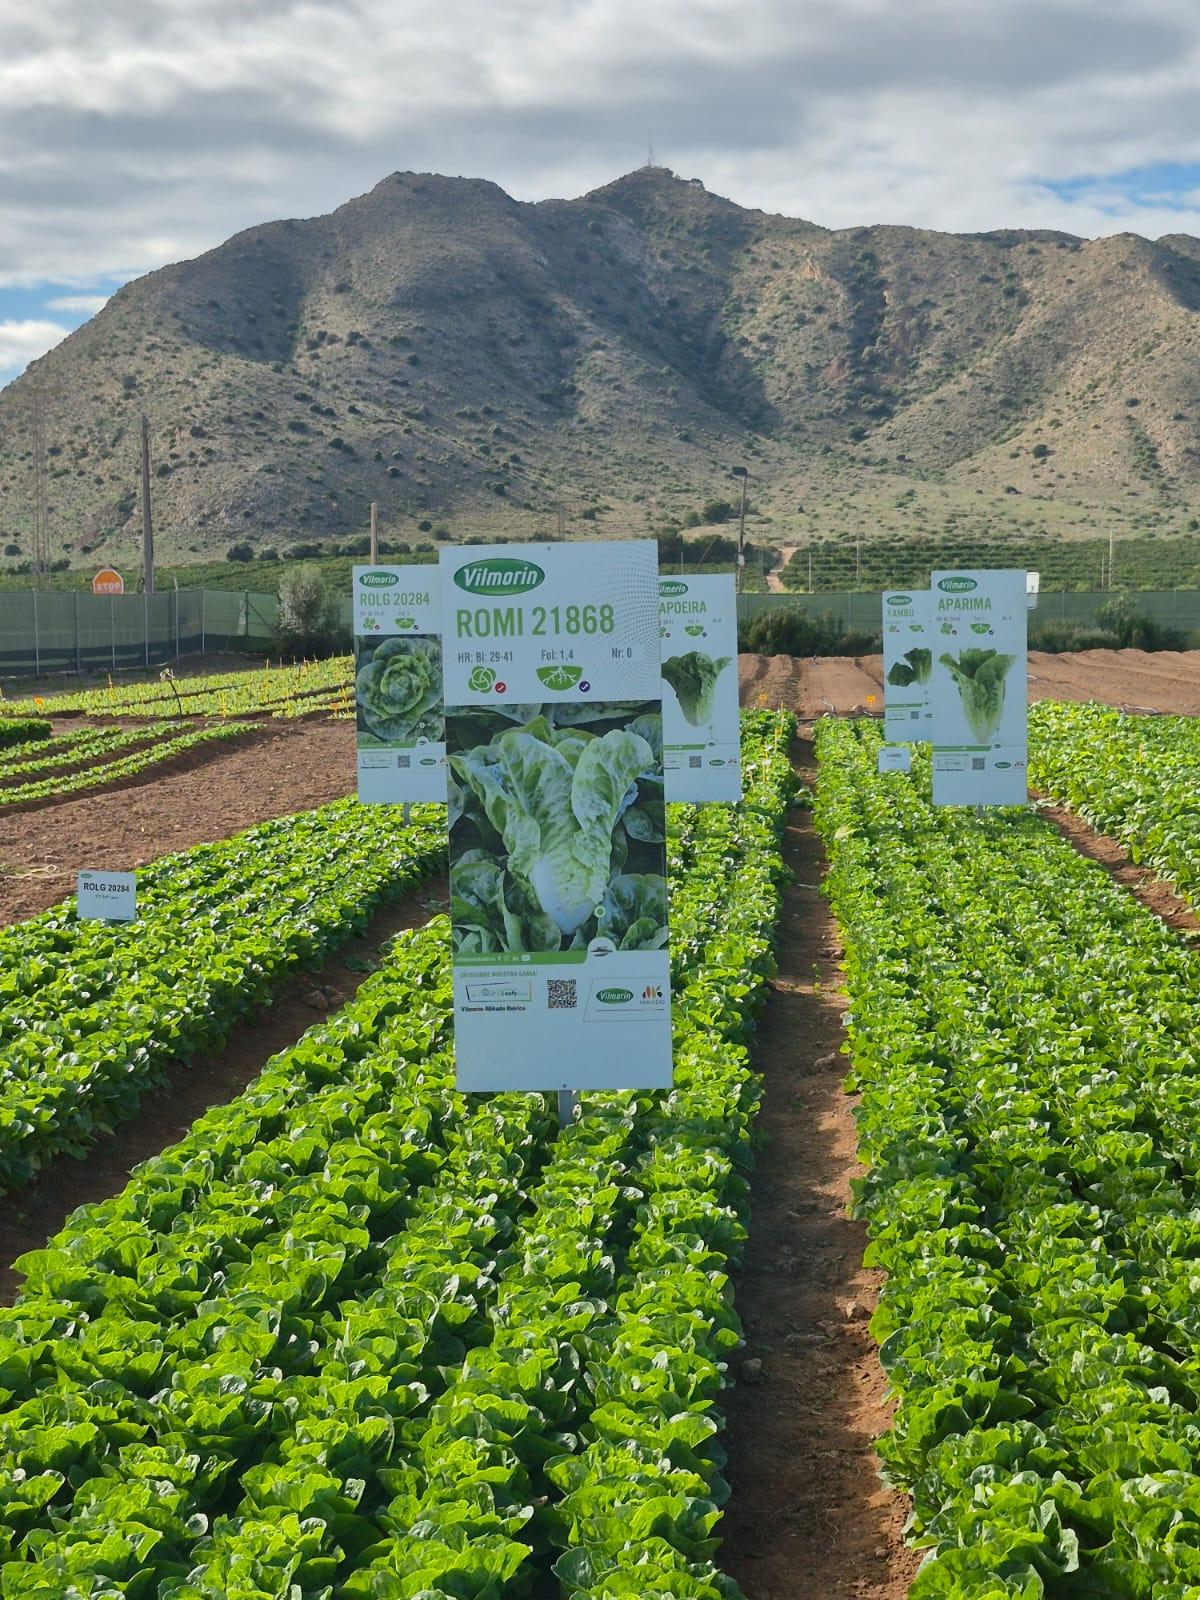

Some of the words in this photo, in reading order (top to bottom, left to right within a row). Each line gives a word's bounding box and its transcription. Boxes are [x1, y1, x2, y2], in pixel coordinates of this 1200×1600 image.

[362, 575, 397, 585] Vilmorin
[463, 566, 538, 588] Vilmorin
[96, 583, 121, 591] STOP
[658, 583, 686, 593] ilmorin
[942, 581, 975, 590] Vilmorin
[360, 593, 391, 606] ROLG
[393, 592, 431, 606] 20284
[938, 597, 992, 611] APARIMA
[456, 607, 523, 638] ROMI
[532, 604, 615, 636] 21868
[457, 652, 474, 663] HR:
[489, 651, 513, 662] 29-41
[541, 649, 558, 661] Fol:
[611, 647, 624, 659] Nr:
[626, 647, 632, 658] 0
[84, 883, 106, 891] ROLG
[108, 884, 130, 892] 20284
[501, 989, 518, 997] Leafy
[600, 991, 632, 1001] Vilmorin
